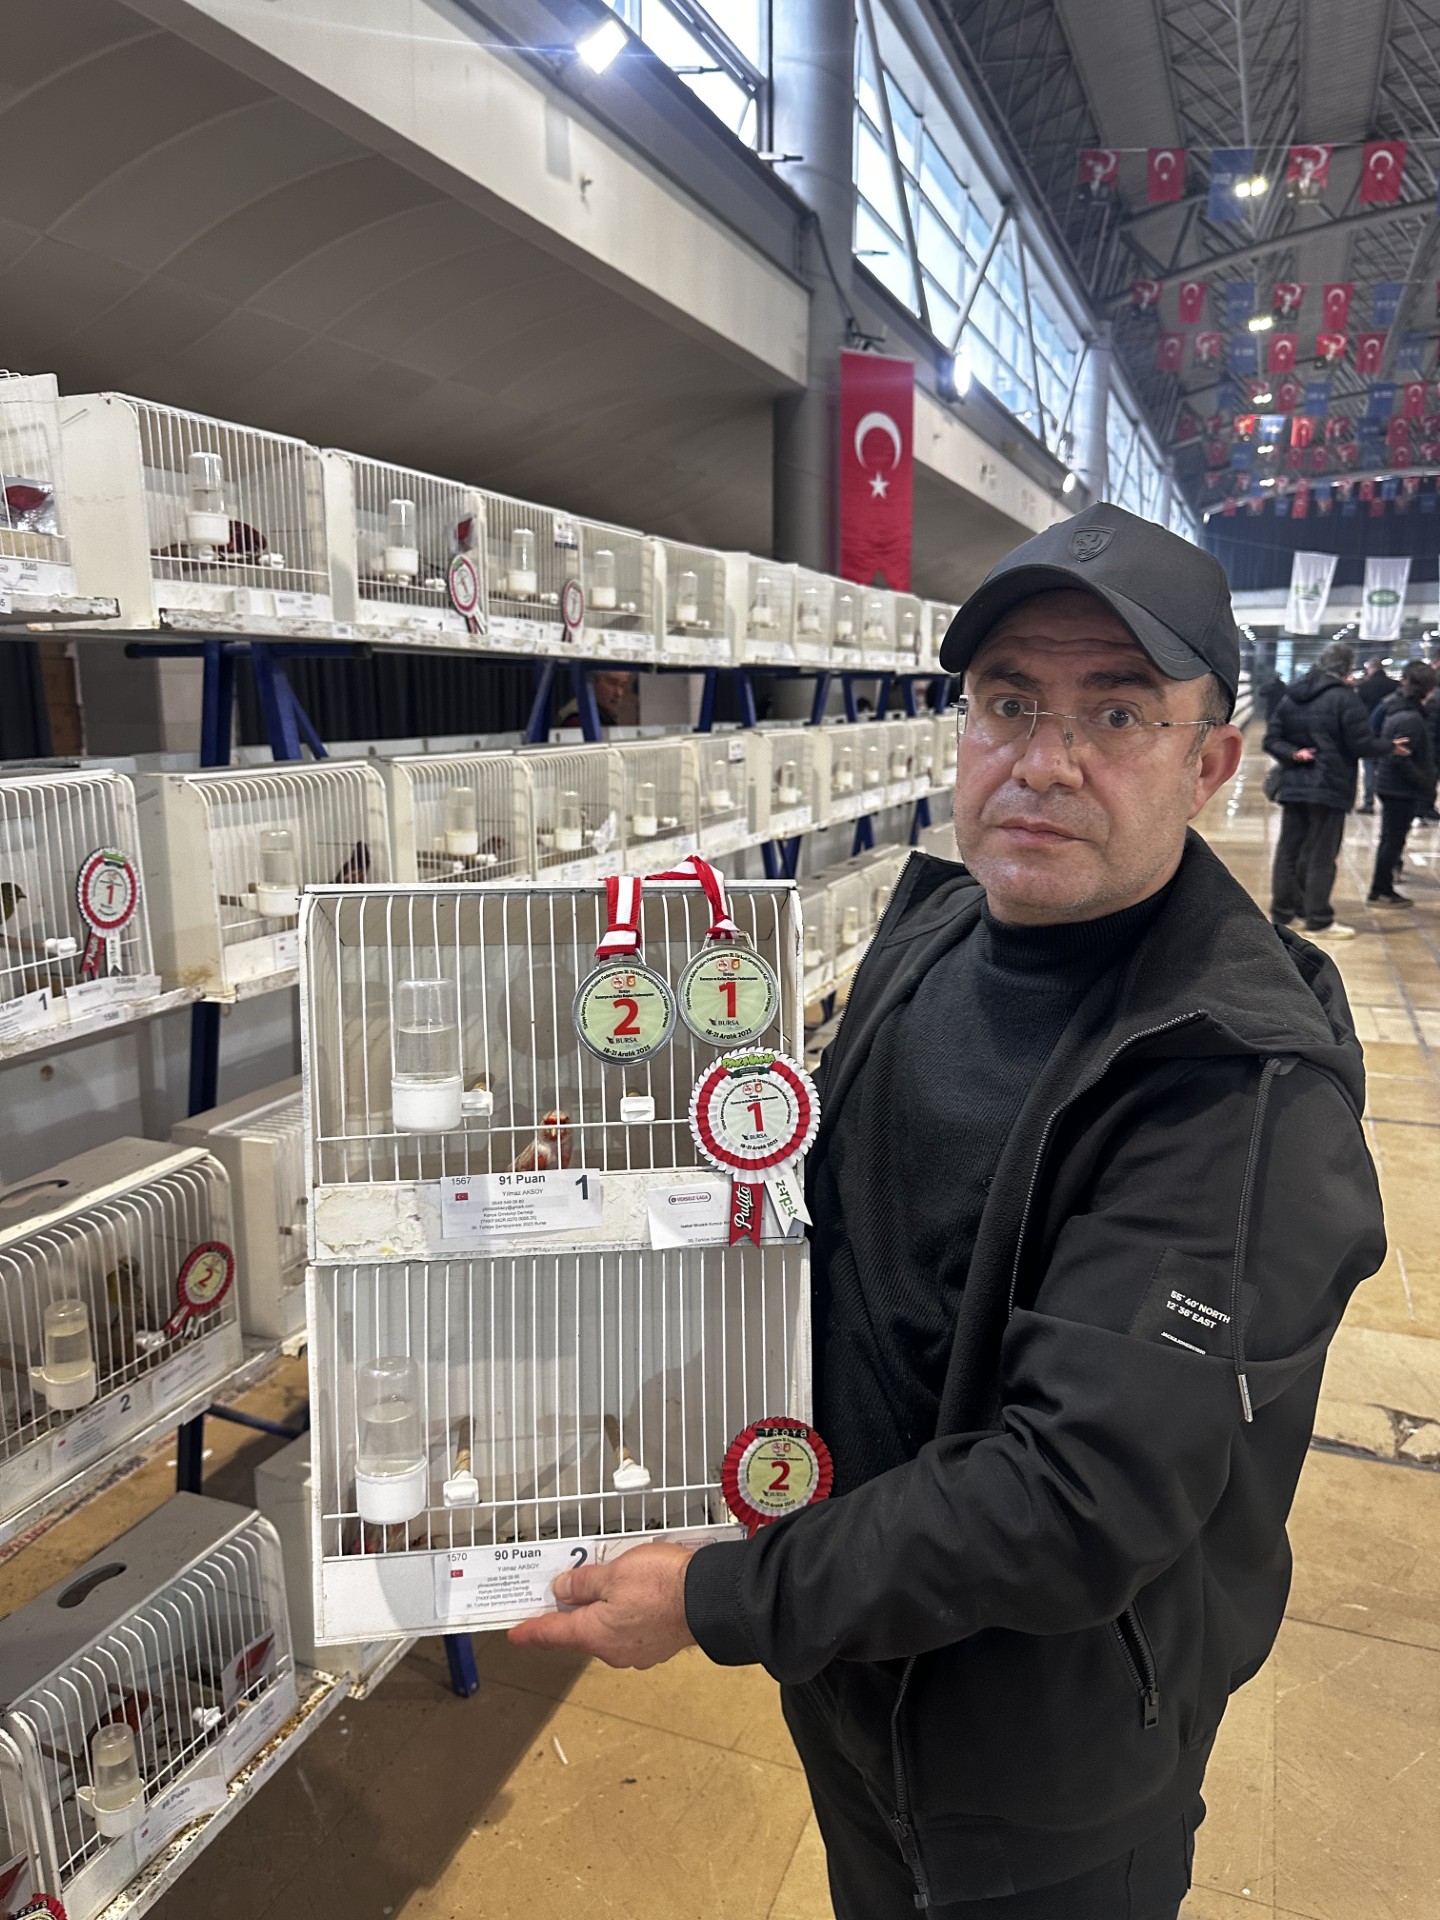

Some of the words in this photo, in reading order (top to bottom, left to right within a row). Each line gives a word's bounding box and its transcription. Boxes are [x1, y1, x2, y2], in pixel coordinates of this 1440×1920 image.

[106, 884, 114, 905] 1
[38, 992, 48, 1011] 1
[718, 981, 736, 1018] 1
[612, 998, 640, 1036] 2
[746, 1101, 764, 1132] 1
[451, 1176, 472, 1186] 1567
[499, 1175, 511, 1186] 91
[516, 1174, 546, 1184] Puan
[575, 1174, 589, 1200] 1
[522, 1188, 544, 1196] AKSOY
[198, 1267, 213, 1288] 2
[1191, 1313, 1217, 1329] EAST
[1198, 1303, 1231, 1324] NORTH
[120, 1393, 131, 1413] 2
[769, 1460, 790, 1491] 2
[447, 1552, 468, 1563] 1570
[494, 1550, 509, 1561] 90
[512, 1548, 541, 1559] Puan
[570, 1546, 588, 1569] 2
